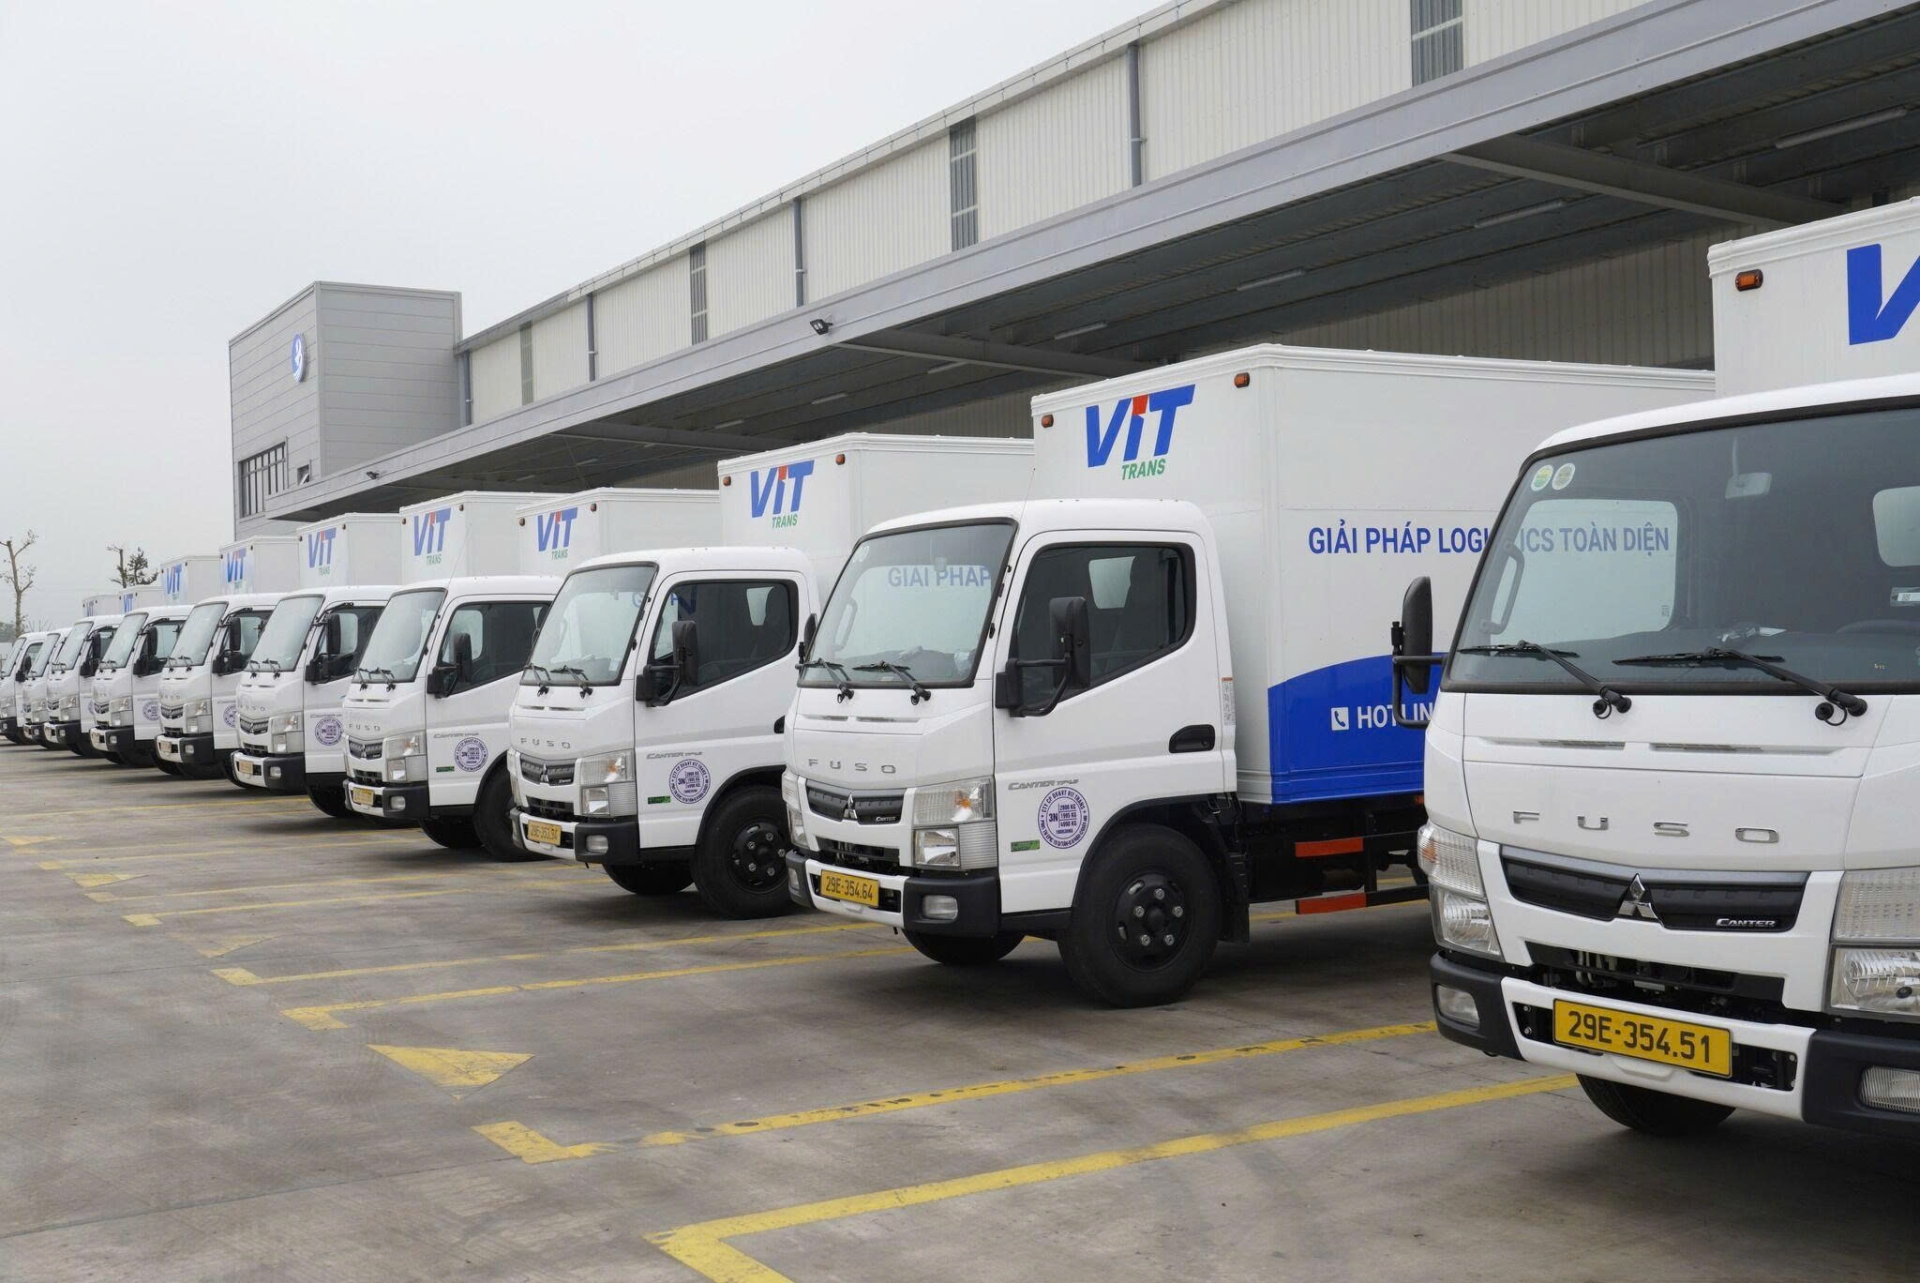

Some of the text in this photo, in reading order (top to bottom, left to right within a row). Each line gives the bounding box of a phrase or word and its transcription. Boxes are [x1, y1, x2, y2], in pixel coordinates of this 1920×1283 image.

[1121, 458, 1167, 480] TRANS
[772, 515, 798, 529] TRANS
[1308, 519, 1669, 556] GIẢI PHÁP LOGIICS TOÀN DIỆN
[1357, 702, 1435, 729] HOTLIN
[521, 737, 570, 749] FUSO
[808, 758, 896, 774] FUSO
[1048, 813, 1058, 822] 3N
[1513, 811, 1779, 843] FUSO
[826, 875, 873, 901] 29E-354.64
[1716, 918, 1776, 928] CANTER
[1568, 1010, 1710, 1063] 29E-354.51
